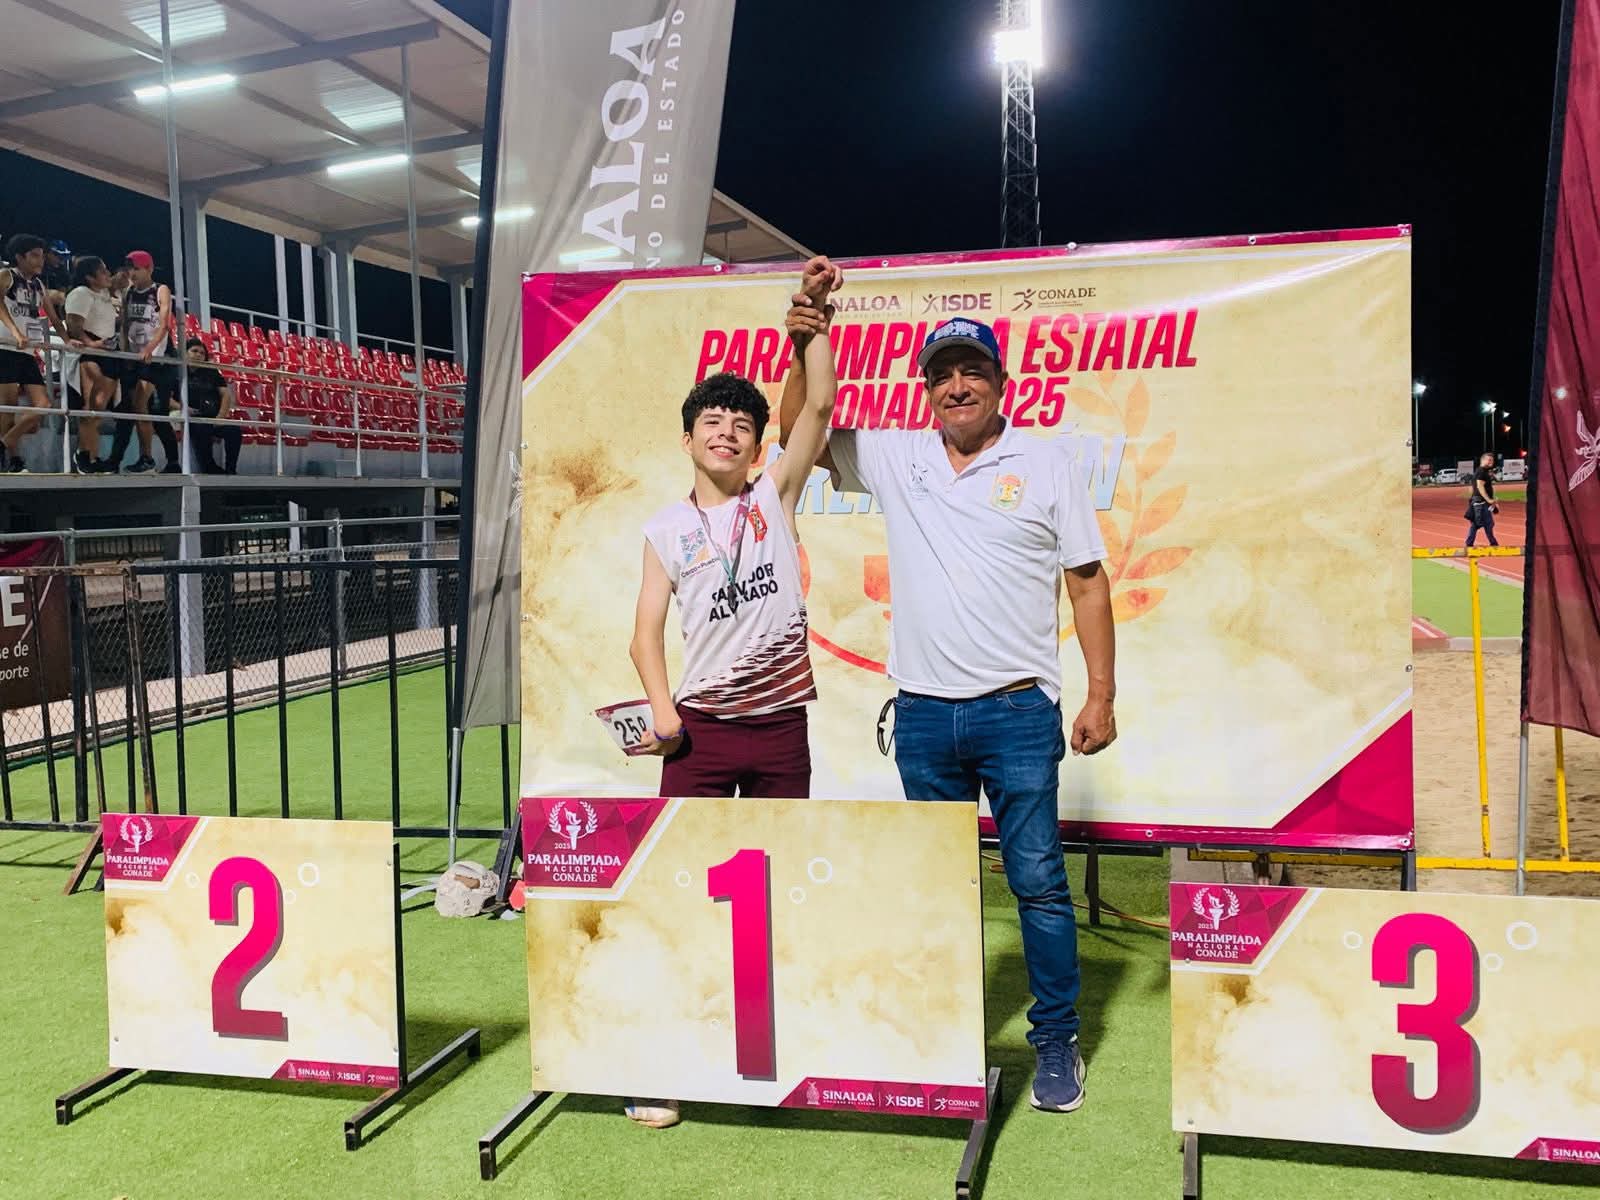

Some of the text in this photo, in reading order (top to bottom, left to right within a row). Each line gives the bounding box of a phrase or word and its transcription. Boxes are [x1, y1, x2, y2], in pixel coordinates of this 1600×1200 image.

[657, 9, 686, 131] ESTADO
[578, 17, 667, 272] ALOA
[651, 152, 671, 209] DEL
[1038, 287, 1096, 299] CONADE
[831, 295, 902, 313] NALOA
[941, 292, 992, 312] ISDE
[1020, 308, 1198, 374] ESTATAL
[829, 376, 1071, 431] ONAD 25
[13, 640, 29, 657] de
[106, 855, 168, 865] PARALIMPIADA
[527, 853, 621, 866] PARALIMPIADA
[544, 865, 604, 873] NACIONAL
[552, 872, 597, 882] CONADE
[1171, 931, 1261, 945] PARALIMPIADA
[208, 856, 289, 1042] 2
[1187, 942, 1246, 951] NACIONAL
[1195, 948, 1238, 959] CONADE
[707, 848, 777, 1082] 1
[1371, 912, 1481, 1136] 3
[822, 1089, 875, 1102] SINALOA
[896, 1096, 923, 1108] ISDE
[1551, 1147, 1600, 1160] SINALOA
